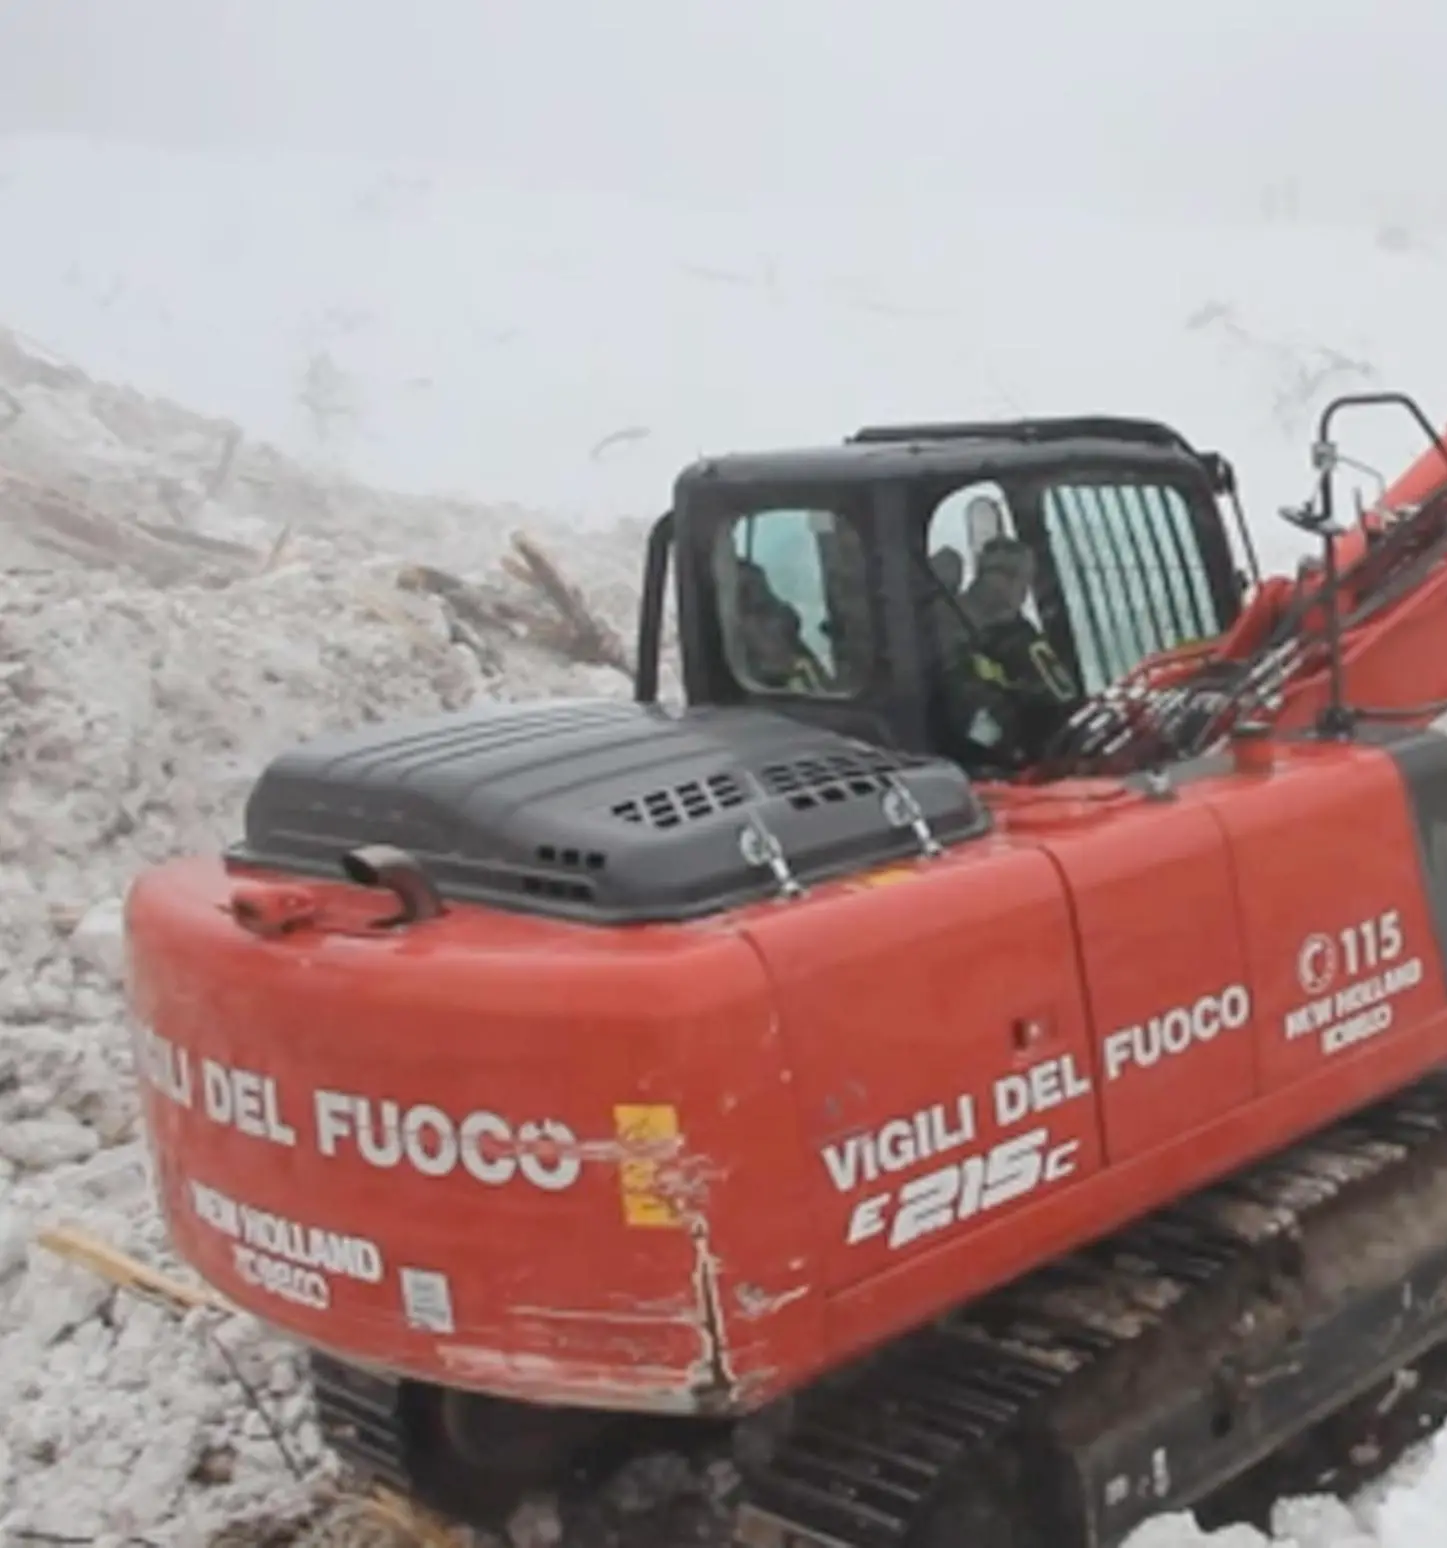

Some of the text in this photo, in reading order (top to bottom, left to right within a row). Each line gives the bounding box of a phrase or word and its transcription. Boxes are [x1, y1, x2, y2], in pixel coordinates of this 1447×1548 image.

[1340, 909, 1403, 976] 115
[202, 1056, 297, 1147] DEL
[313, 1089, 583, 1191] FUOCO
[822, 985, 1250, 1193] VIGILI DEL FUOCO
